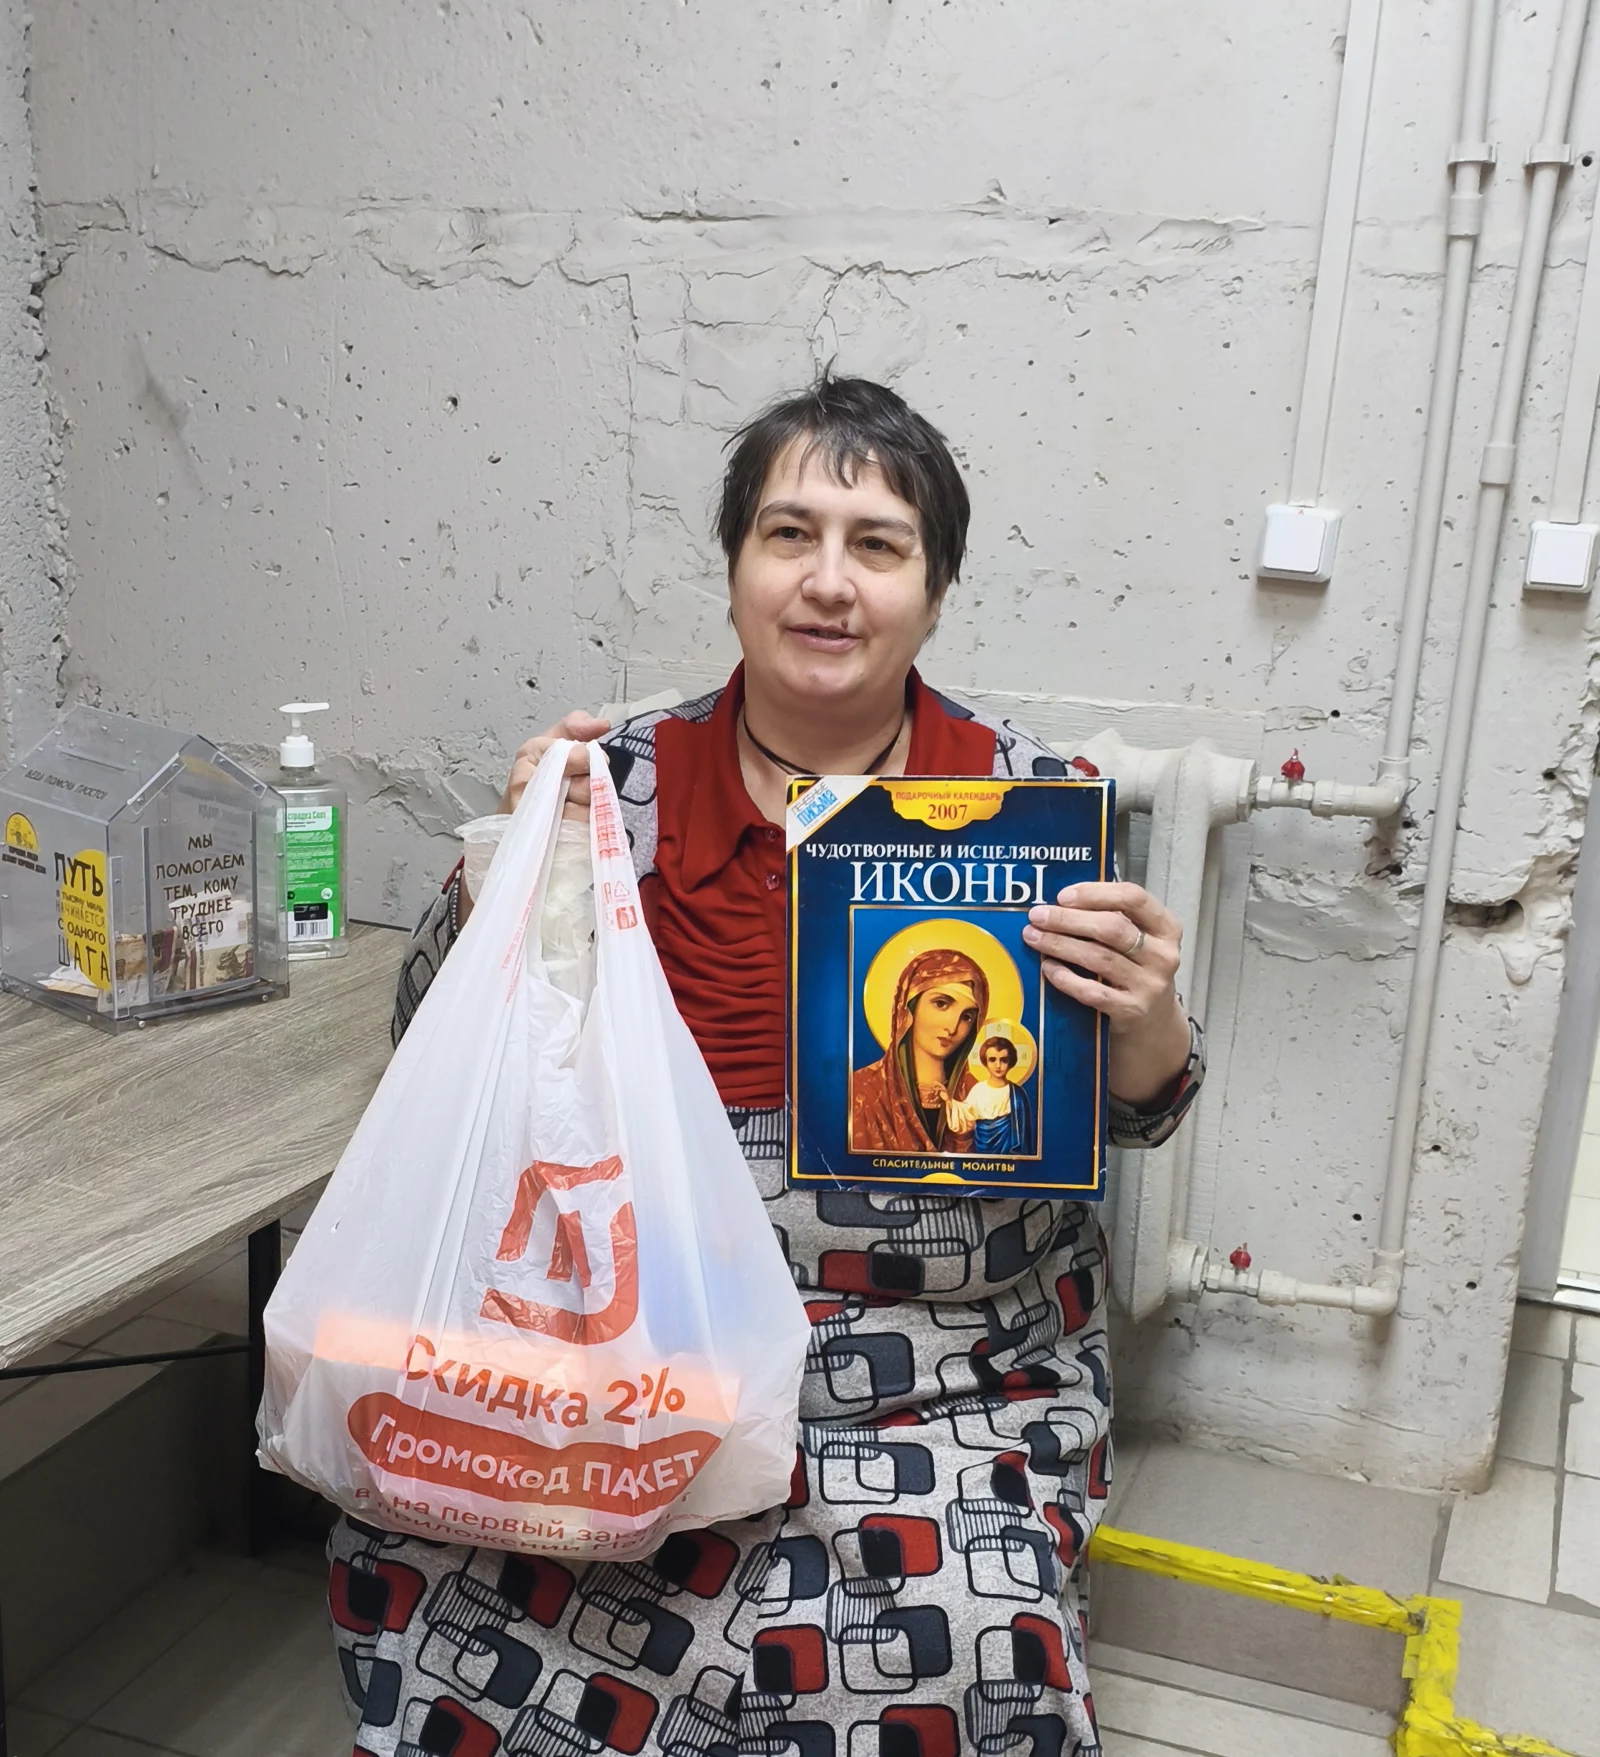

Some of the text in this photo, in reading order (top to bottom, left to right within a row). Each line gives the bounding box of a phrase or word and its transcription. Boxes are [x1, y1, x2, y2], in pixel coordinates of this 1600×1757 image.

[896, 791, 1001, 801] ПОДАРОЧНЫЙ КАЛЕНДАРЬ
[928, 804, 968, 820] 2007
[188, 833, 213, 851] МЫ
[806, 843, 1092, 862] ЧУДОТВОРНЫЕ И ИСЦЕЛЯЮЩИЕ
[54, 852, 104, 897] ПУТЬ
[156, 854, 245, 880] ПОМОГАЕМ
[163, 875, 238, 901] ТЕМ, КОМУ
[850, 861, 1049, 904] ИКОНЫ
[55, 899, 106, 929] НАЧИНАЕТСЯ
[170, 897, 233, 920] ТРУДНЕЕ
[58, 917, 106, 946] С ОДНОГО
[182, 919, 224, 940] ВСЕГО
[58, 934, 111, 982] ШАГА
[872, 1159, 1015, 1172] СПАСИТЕЛЬНЫЕ МОЛИТВЫ
[404, 1335, 686, 1428] Скидка 2%
[583, 1449, 699, 1500] ПАКЕТ
[393, 1496, 430, 1515] на
[441, 1505, 565, 1540] первый
